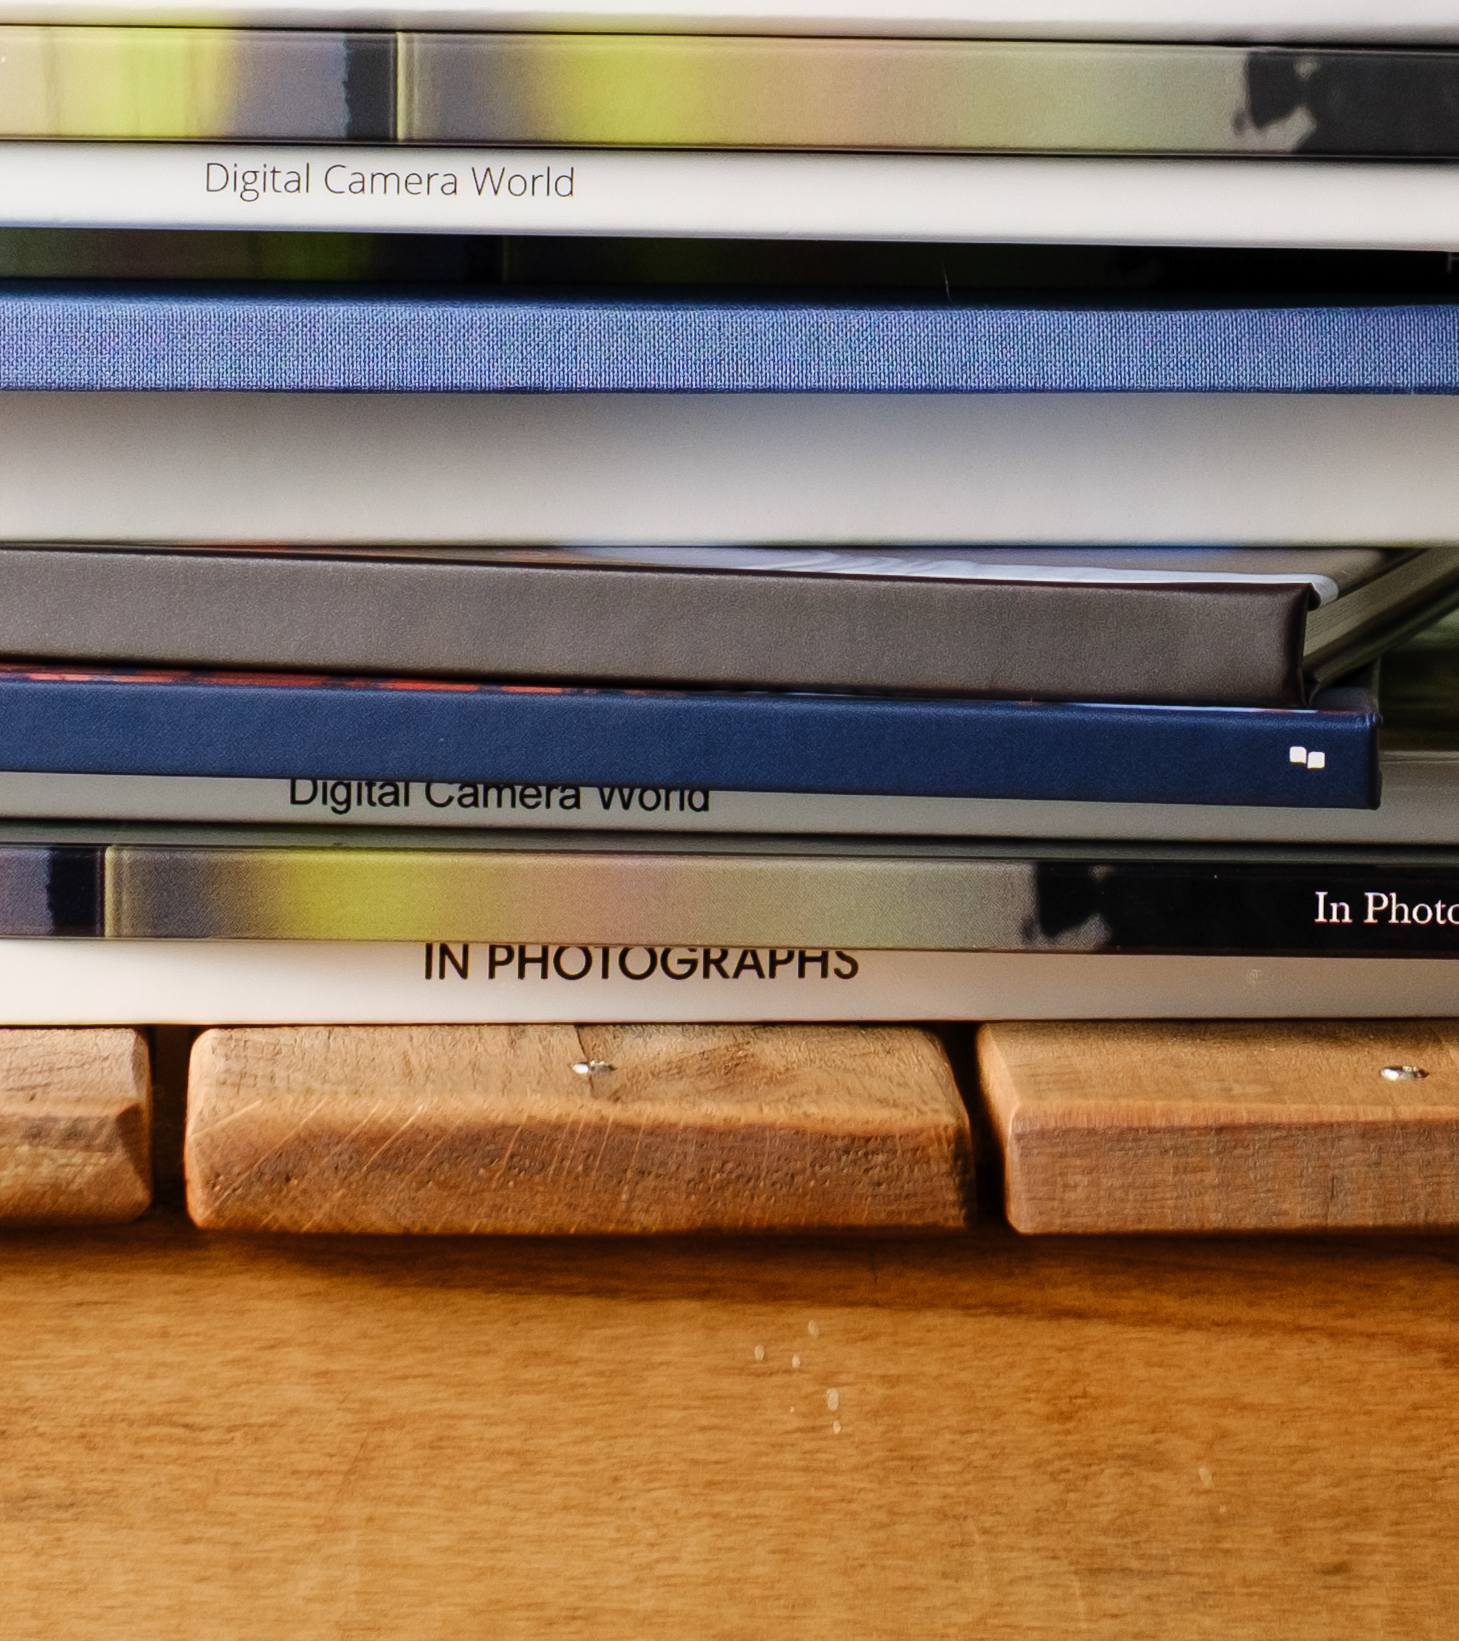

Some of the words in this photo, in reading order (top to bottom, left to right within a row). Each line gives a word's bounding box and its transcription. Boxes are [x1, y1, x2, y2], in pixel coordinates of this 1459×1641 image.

[206, 162, 310, 201] Digital
[324, 164, 458, 196] Camera
[471, 166, 575, 197] World
[289, 779, 410, 815] Digital
[424, 782, 581, 811] Camera
[598, 787, 710, 813] World
[1314, 891, 1353, 923] In
[424, 942, 469, 980] IN
[487, 944, 860, 981] PHOTOGRAPHS
